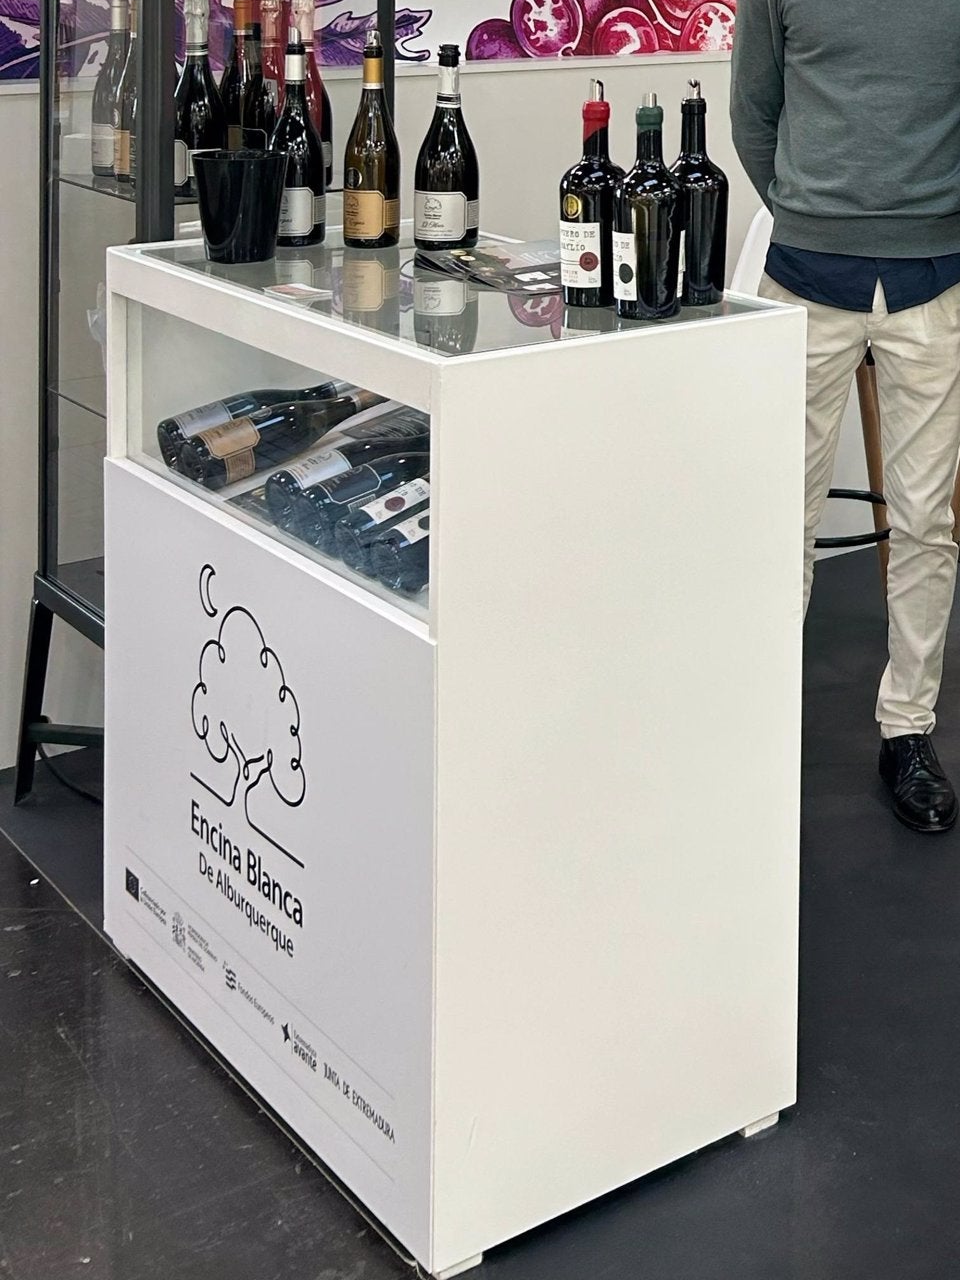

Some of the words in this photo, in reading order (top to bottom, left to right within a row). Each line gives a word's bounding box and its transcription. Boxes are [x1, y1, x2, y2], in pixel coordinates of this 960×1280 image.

[191, 798, 242, 875] Encina
[246, 847, 303, 929] Blanca
[199, 851, 214, 884] De
[215, 868, 294, 959] Alburquerque
